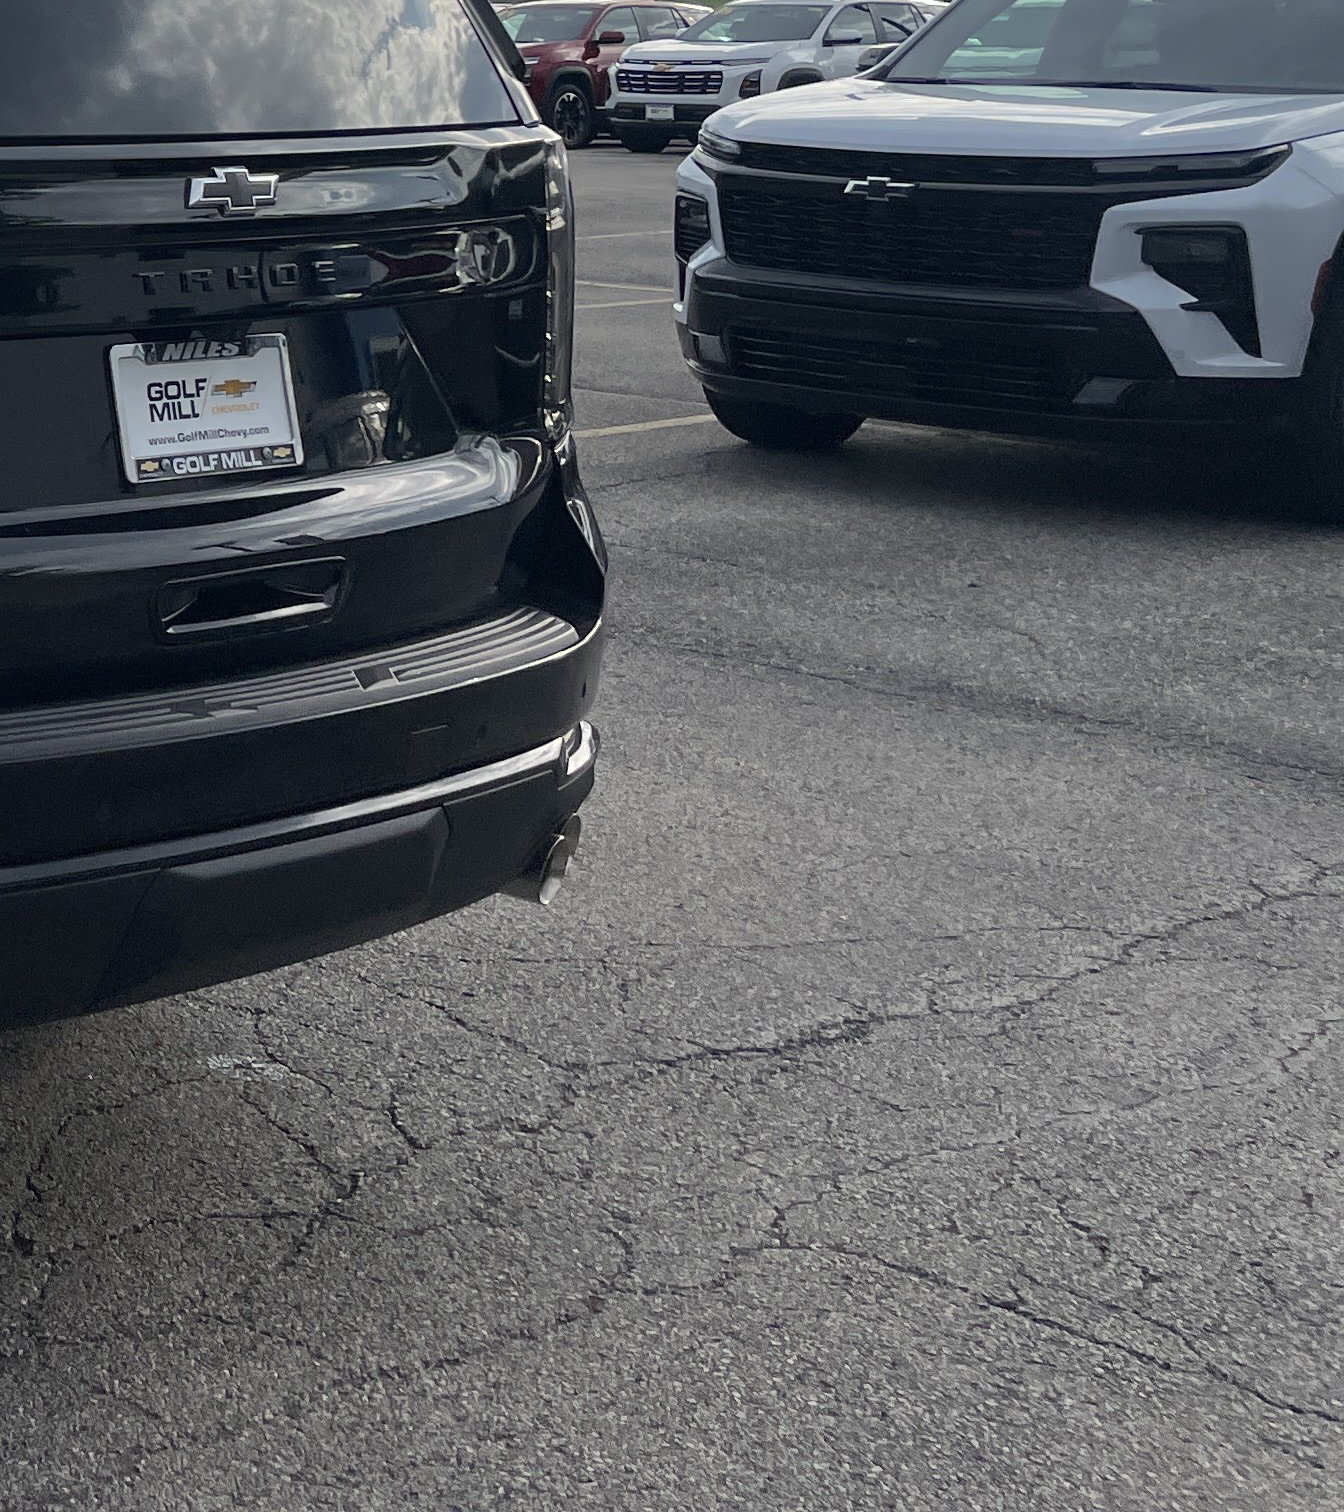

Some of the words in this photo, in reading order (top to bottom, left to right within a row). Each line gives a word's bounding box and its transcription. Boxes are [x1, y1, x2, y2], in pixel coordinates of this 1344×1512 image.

[132, 260, 337, 296] TAHOE
[162, 340, 240, 362] NILES
[146, 377, 208, 402] GOLF
[148, 399, 200, 423] MILL
[148, 426, 270, 446] www.GolfMillChevy.com
[172, 454, 218, 475] GOLF
[221, 449, 263, 470] MILL
